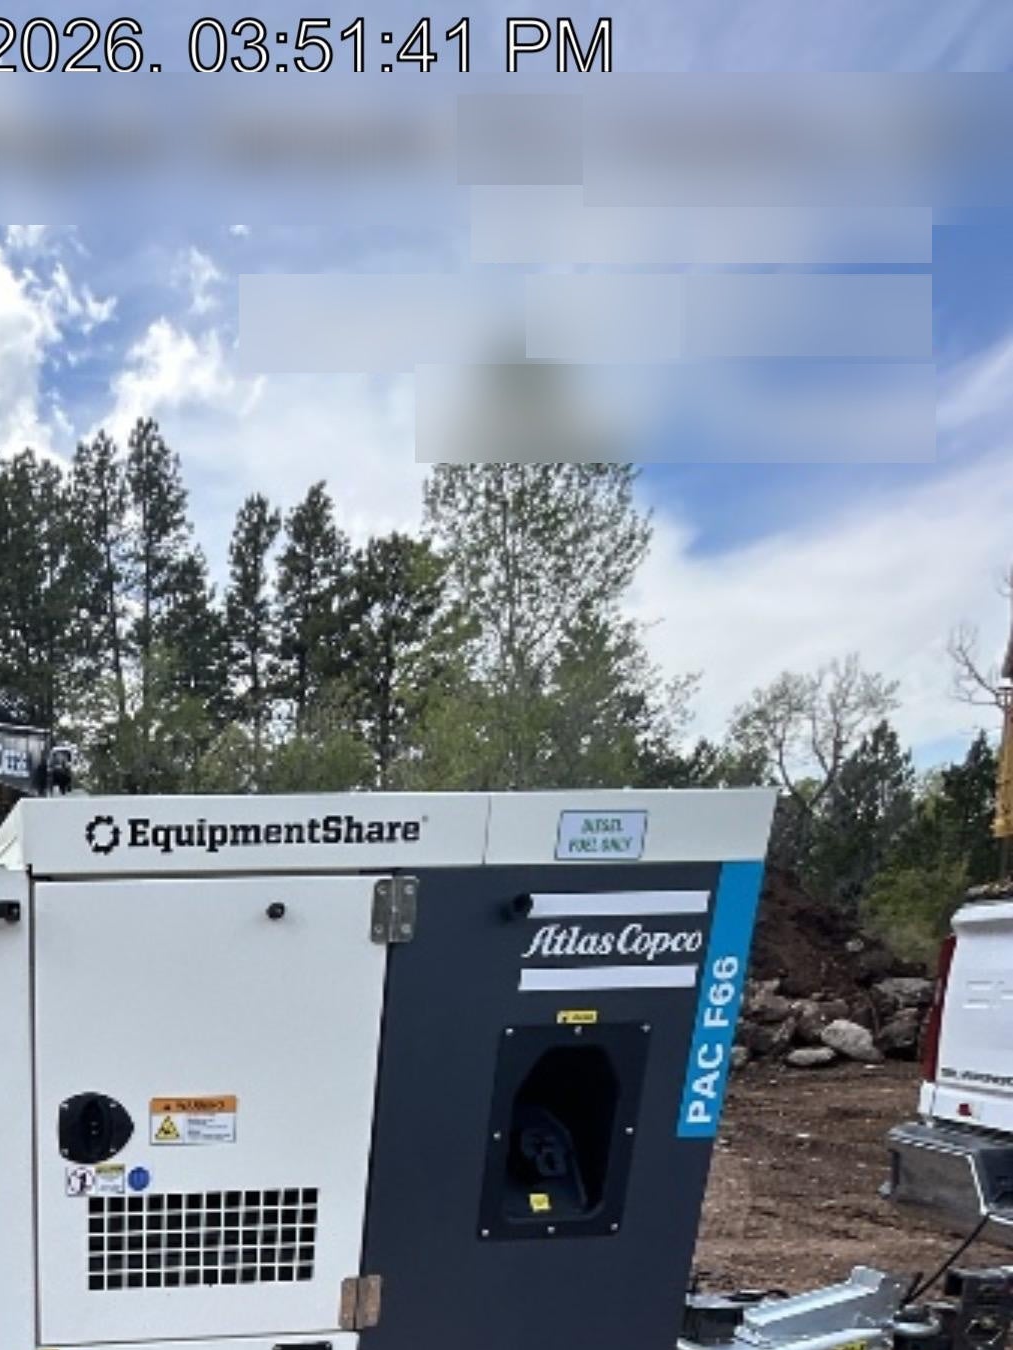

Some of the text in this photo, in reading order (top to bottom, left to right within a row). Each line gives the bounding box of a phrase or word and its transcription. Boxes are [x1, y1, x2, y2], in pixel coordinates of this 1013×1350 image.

[127, 815, 421, 852] EquipmentShare
[521, 922, 703, 961] Atlas Copco
[686, 956, 738, 1123] PAC F66
